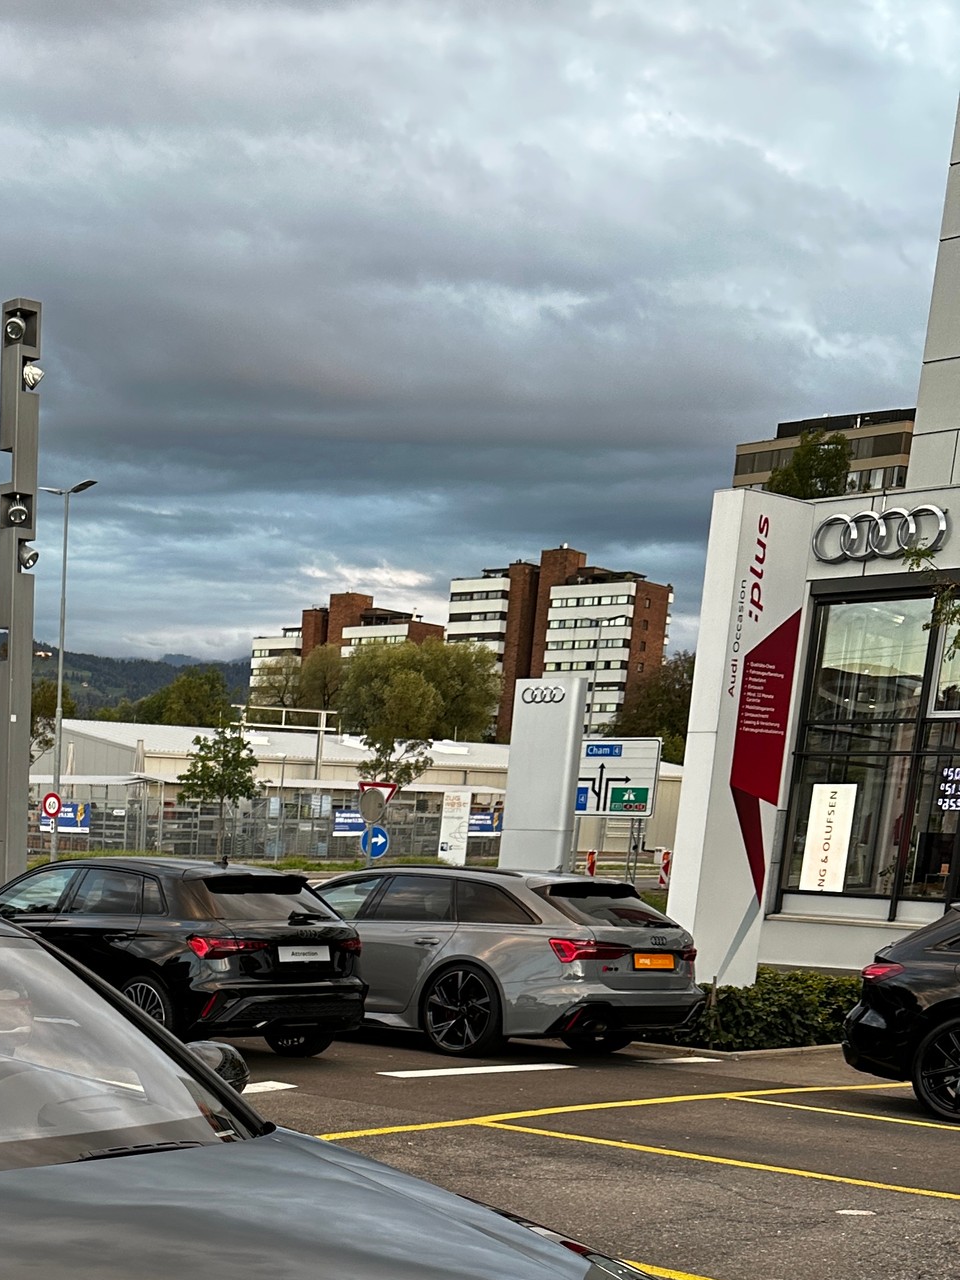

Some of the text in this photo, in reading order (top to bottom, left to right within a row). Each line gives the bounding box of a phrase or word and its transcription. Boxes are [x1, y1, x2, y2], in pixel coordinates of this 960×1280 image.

[727, 579, 747, 698] Audi Occasion
[587, 746, 610, 755] Cham
[48, 801, 56, 810] 60
[822, 791, 838, 852] OLUFSEN
[821, 855, 828, 863] &
